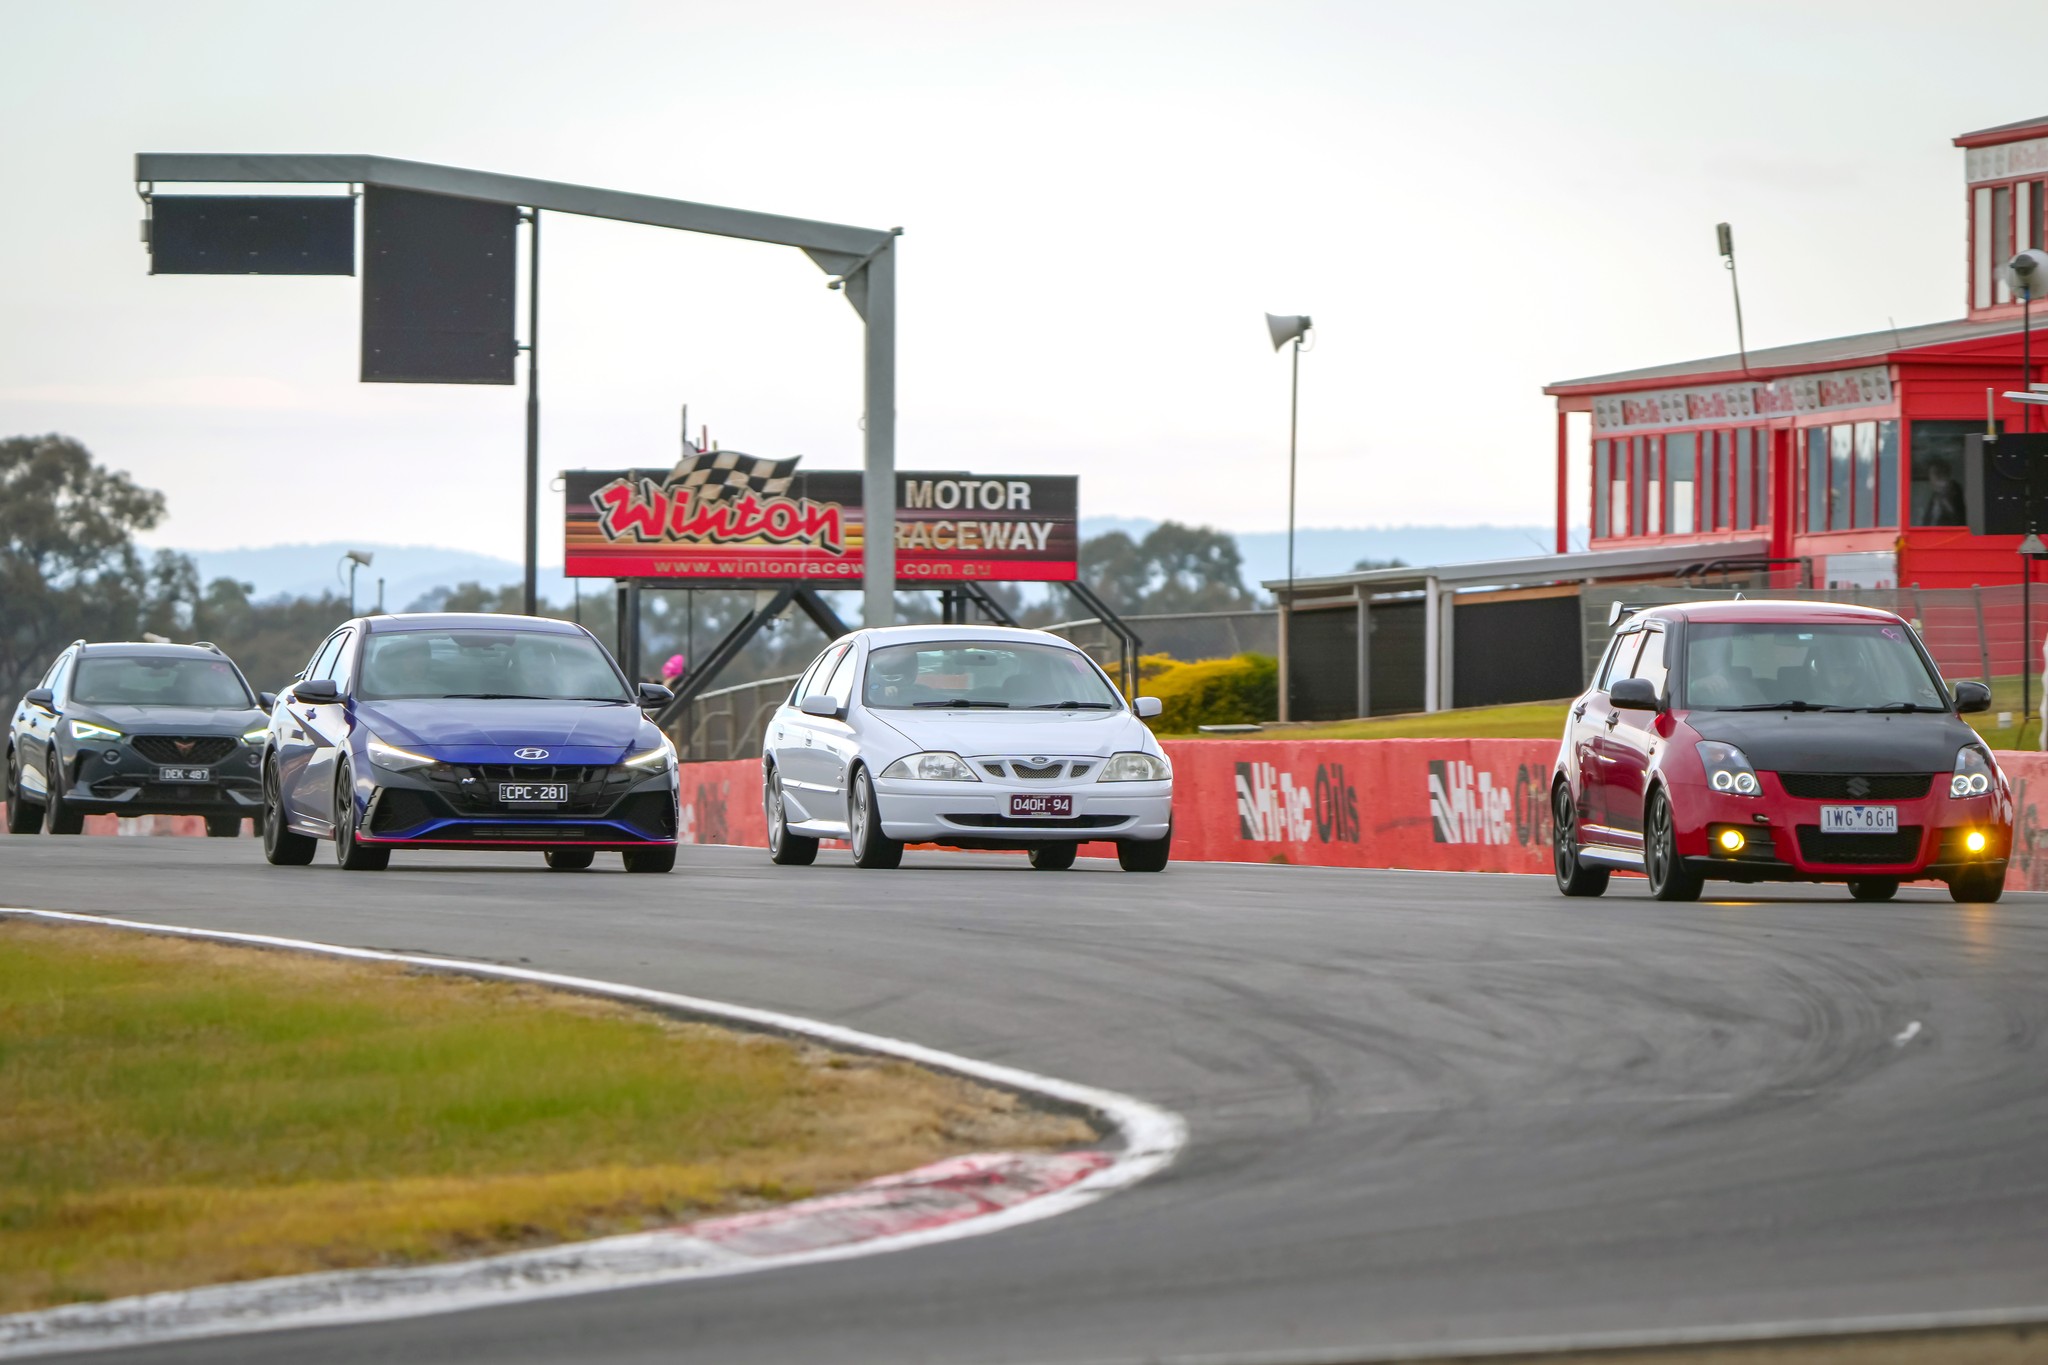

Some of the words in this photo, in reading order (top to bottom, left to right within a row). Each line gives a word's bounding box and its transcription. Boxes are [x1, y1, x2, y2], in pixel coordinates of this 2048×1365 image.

[594, 479, 843, 554] Winton
[905, 480, 1031, 510] MOTOR
[654, 559, 991, 577] www.wintonracew.com.au
[1241, 762, 1312, 842] Hi-Tec
[1315, 763, 1360, 844] Oils
[1435, 760, 1512, 845] Hi-Tec
[1515, 763, 1552, 847] Oil
[1826, 810, 1853, 826] 1WG
[1866, 810, 1894, 827] 8GH
